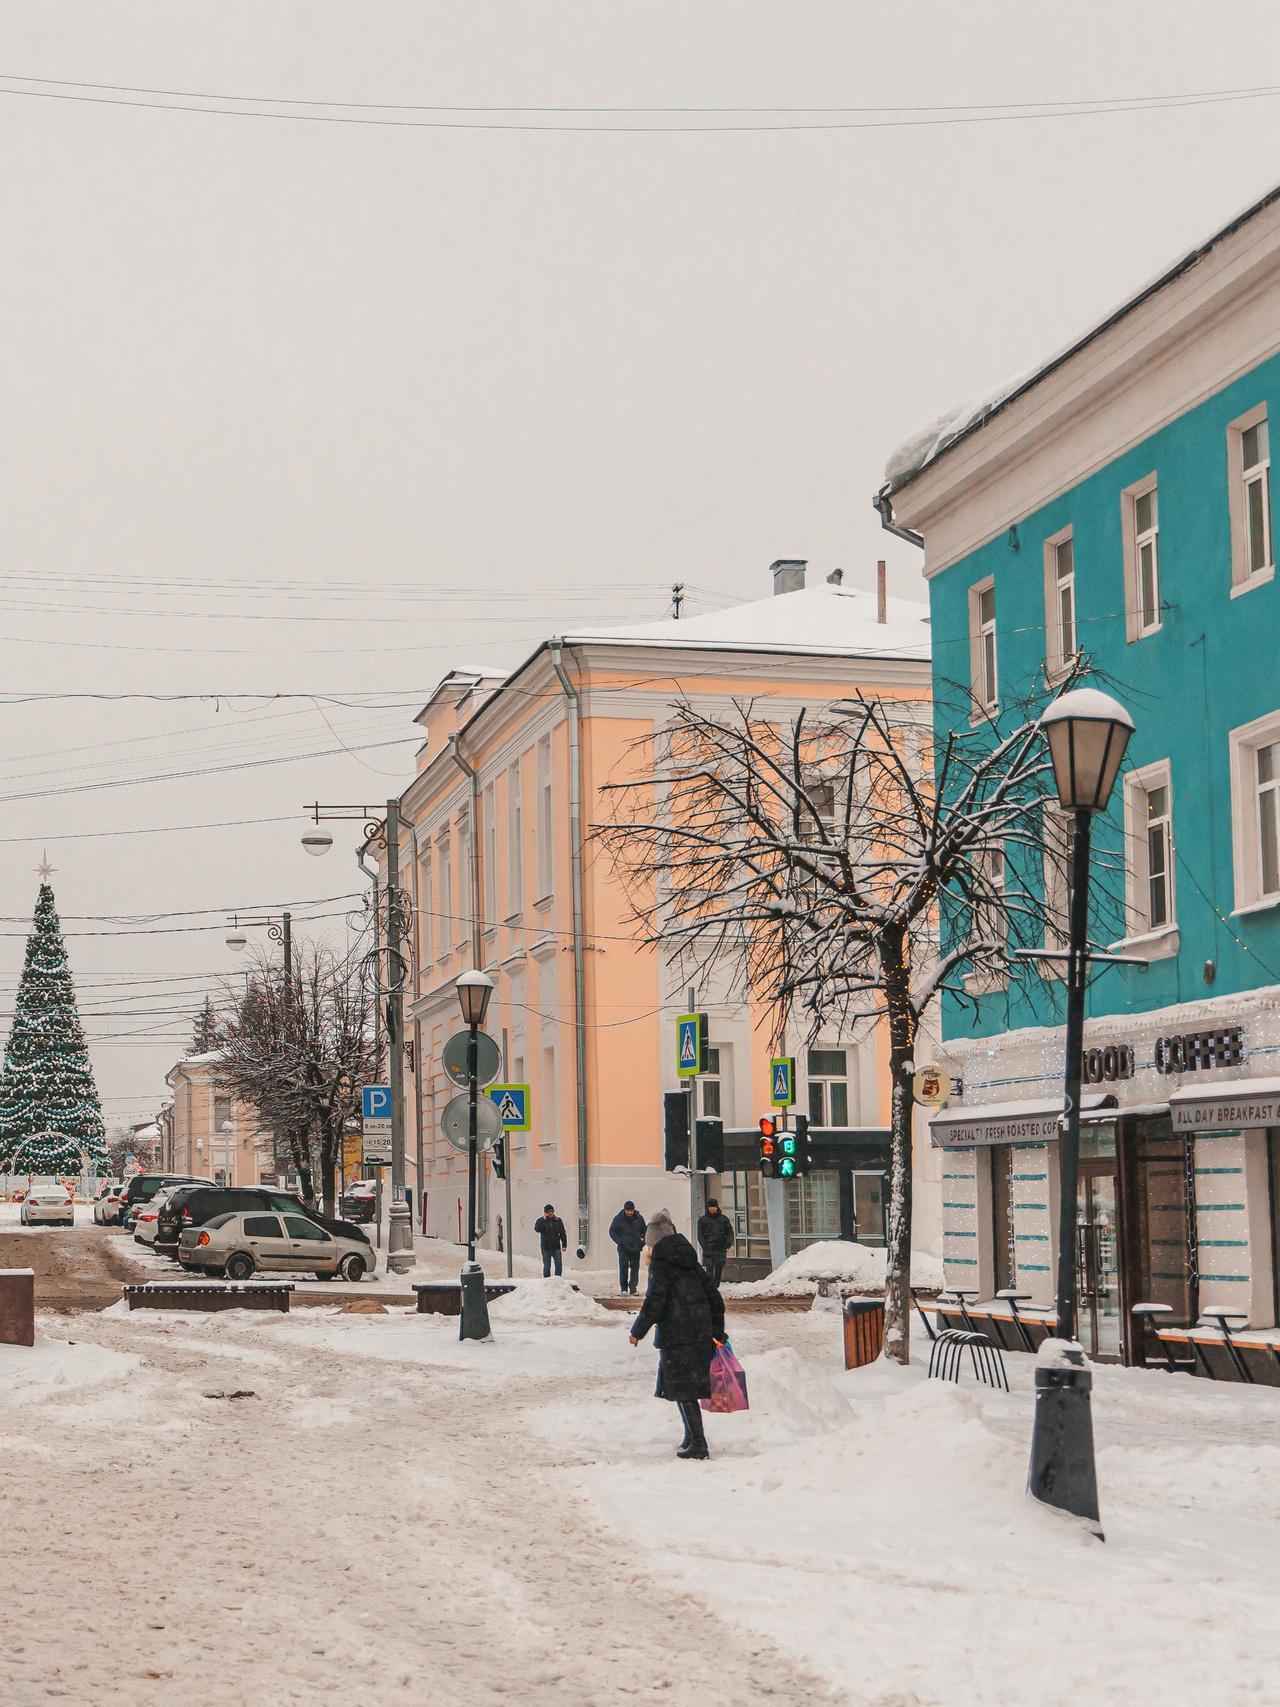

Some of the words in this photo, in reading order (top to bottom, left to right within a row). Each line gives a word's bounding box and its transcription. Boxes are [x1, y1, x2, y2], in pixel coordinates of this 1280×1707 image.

[1081, 1044, 1135, 1084] OOD
[1155, 1026, 1245, 1074] COFFEE
[370, 1091, 387, 1115] P
[1177, 1110, 1192, 1124] ALL
[1195, 1108, 1214, 1123] DAY
[1217, 1104, 1273, 1121] BREAKFAST
[985, 1126, 1005, 1140] FRESH
[1007, 1122, 1040, 1138] ROASTED
